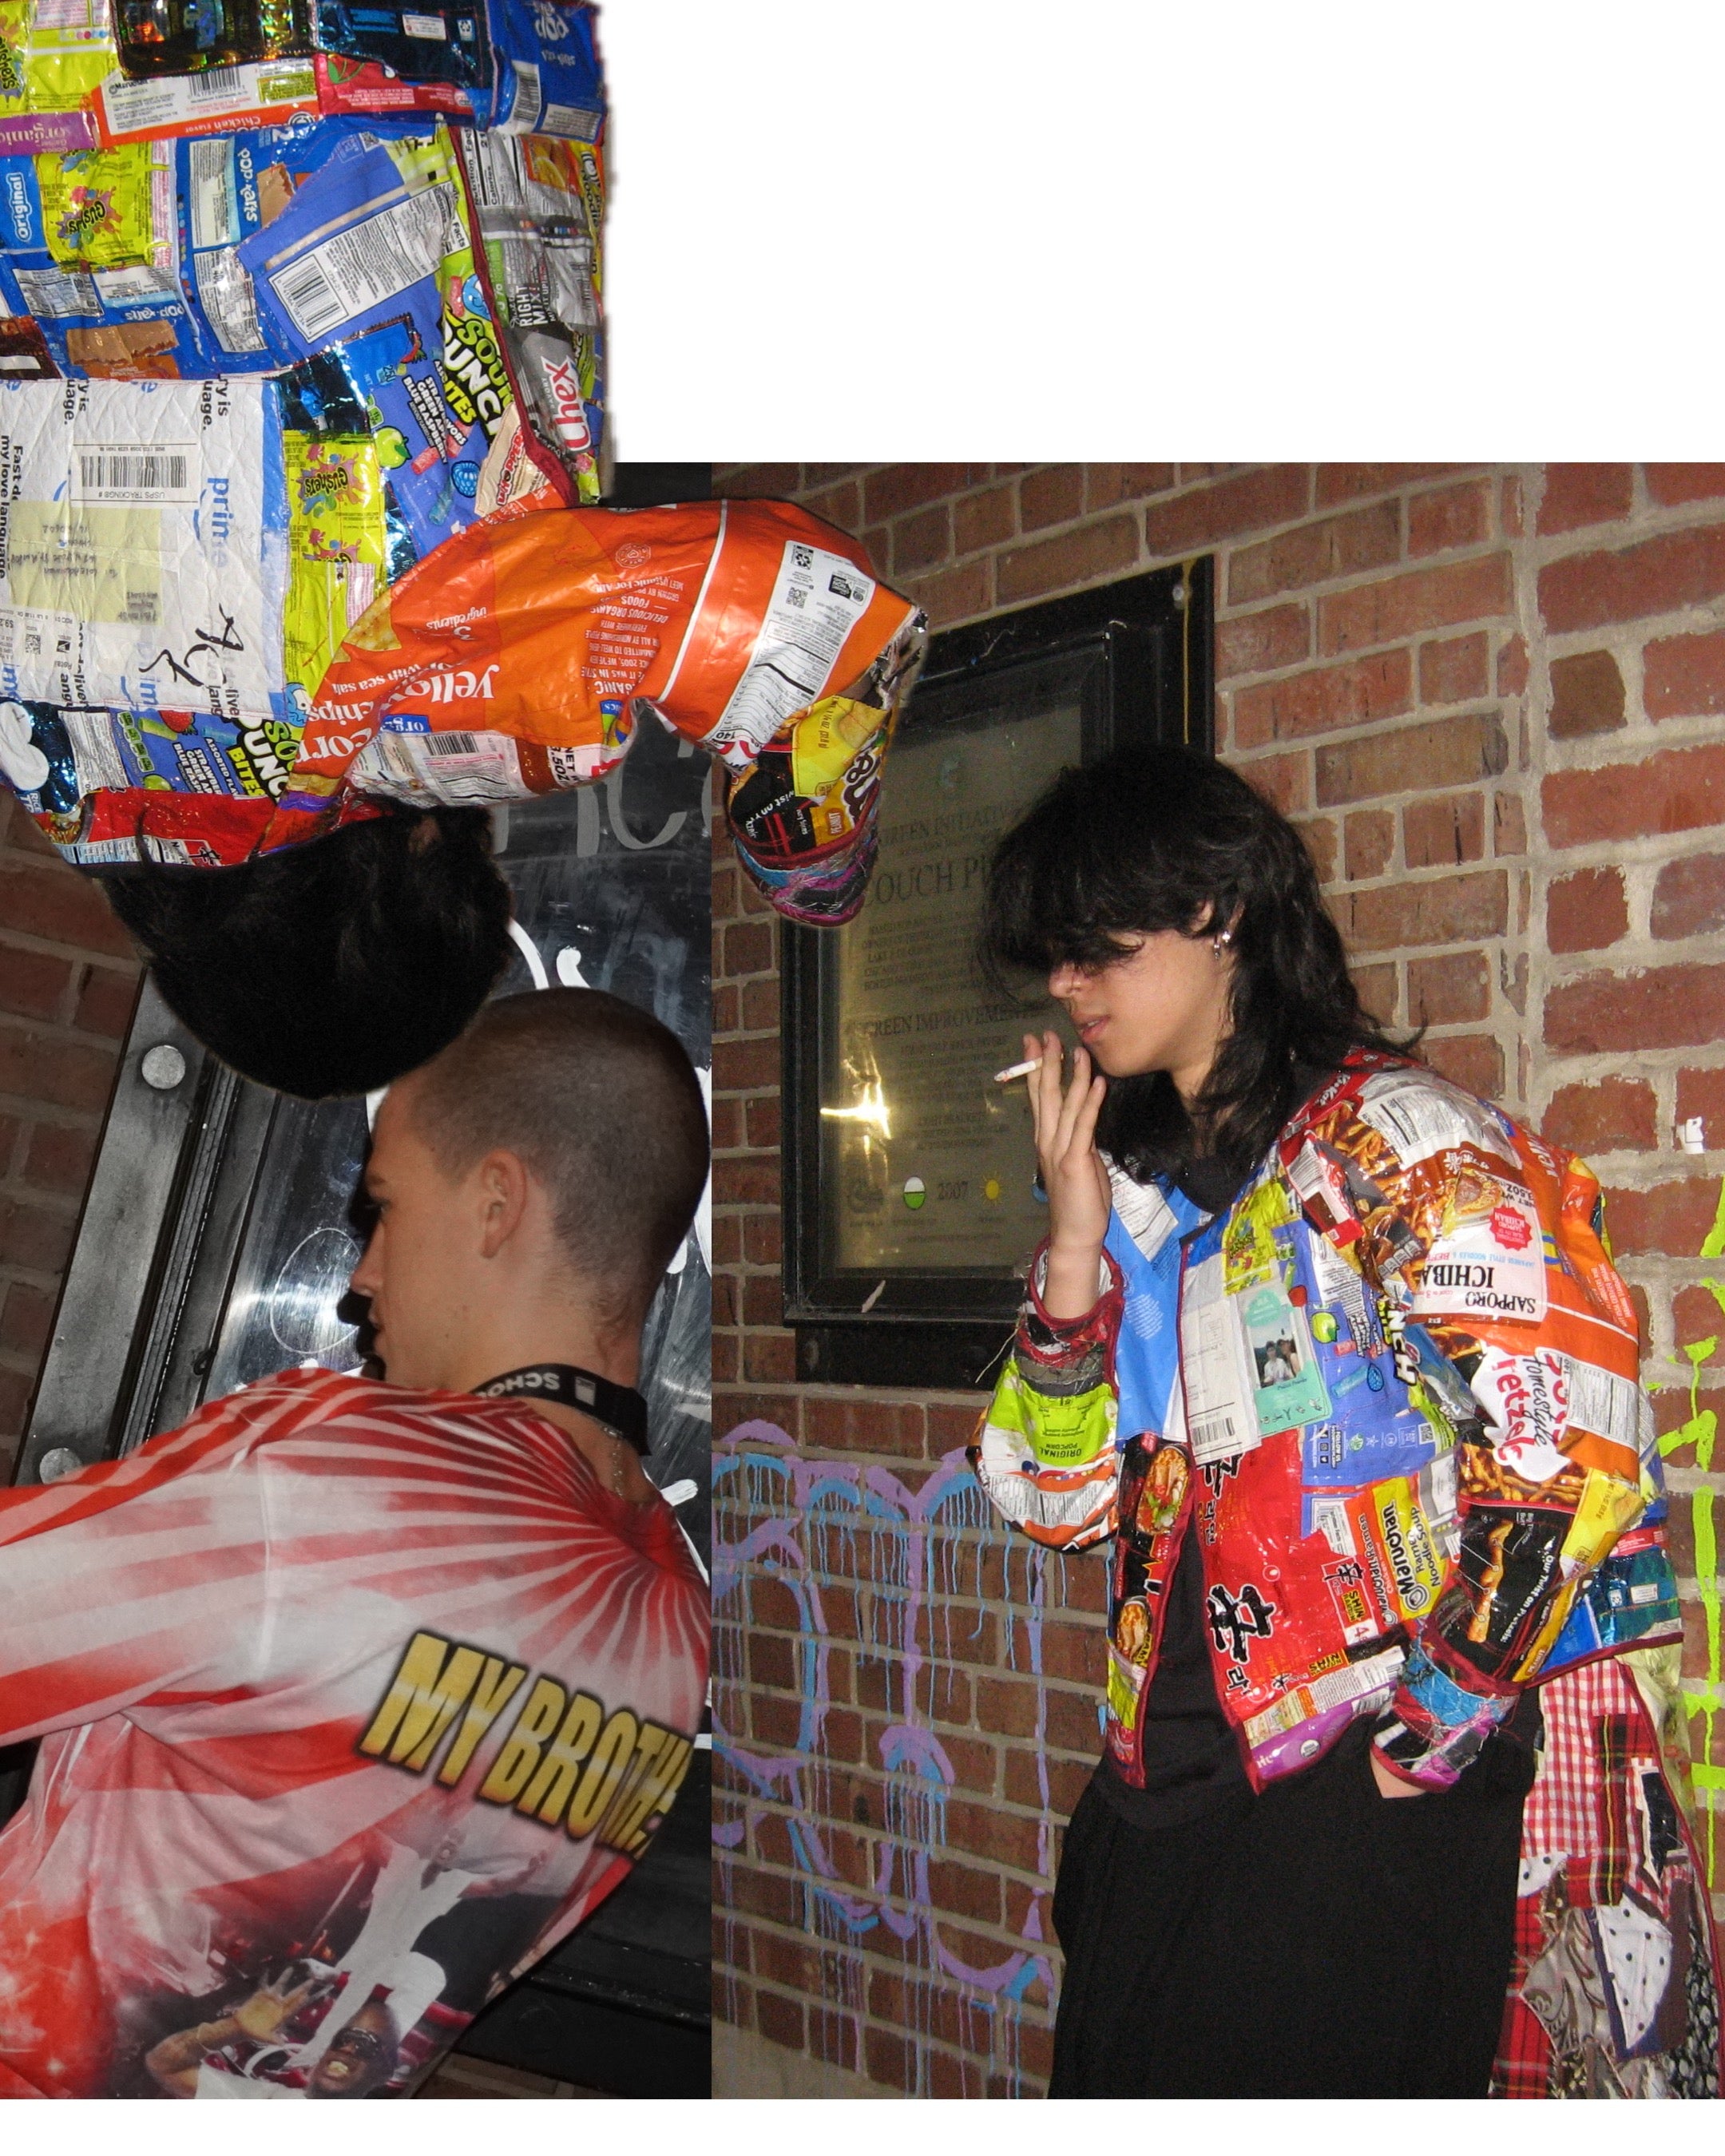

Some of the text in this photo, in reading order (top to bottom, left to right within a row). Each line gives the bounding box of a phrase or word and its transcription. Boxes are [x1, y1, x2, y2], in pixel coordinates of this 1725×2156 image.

[212, 116, 261, 133] Chicken
[8, 172, 30, 241] original
[515, 285, 533, 327] RIGHT
[404, 375, 423, 405] BLUE
[543, 357, 590, 452] Chex
[12, 446, 24, 482] Fast
[1, 464, 11, 498] love
[303, 466, 347, 498] Gushers
[620, 595, 650, 608] FOODS
[628, 608, 668, 624] DELICIOUS
[426, 607, 487, 630] ingredients
[358, 677, 386, 693] sea
[172, 742, 191, 767] BLUE
[186, 750, 207, 782] GREEN
[205, 738, 229, 778] ASSORTED
[30, 792, 42, 814] RICE
[937, 1180, 969, 1201] 2007
[1465, 1291, 1537, 1314] SAPPORO
[1039, 1448, 1083, 1462] ORIGINAL
[1380, 1503, 1415, 1597] Maruchan
[1408, 1506, 1441, 1587] Noodle Soup
[1349, 1590, 1365, 1619] SHIN
[358, 1629, 529, 1791] MY
